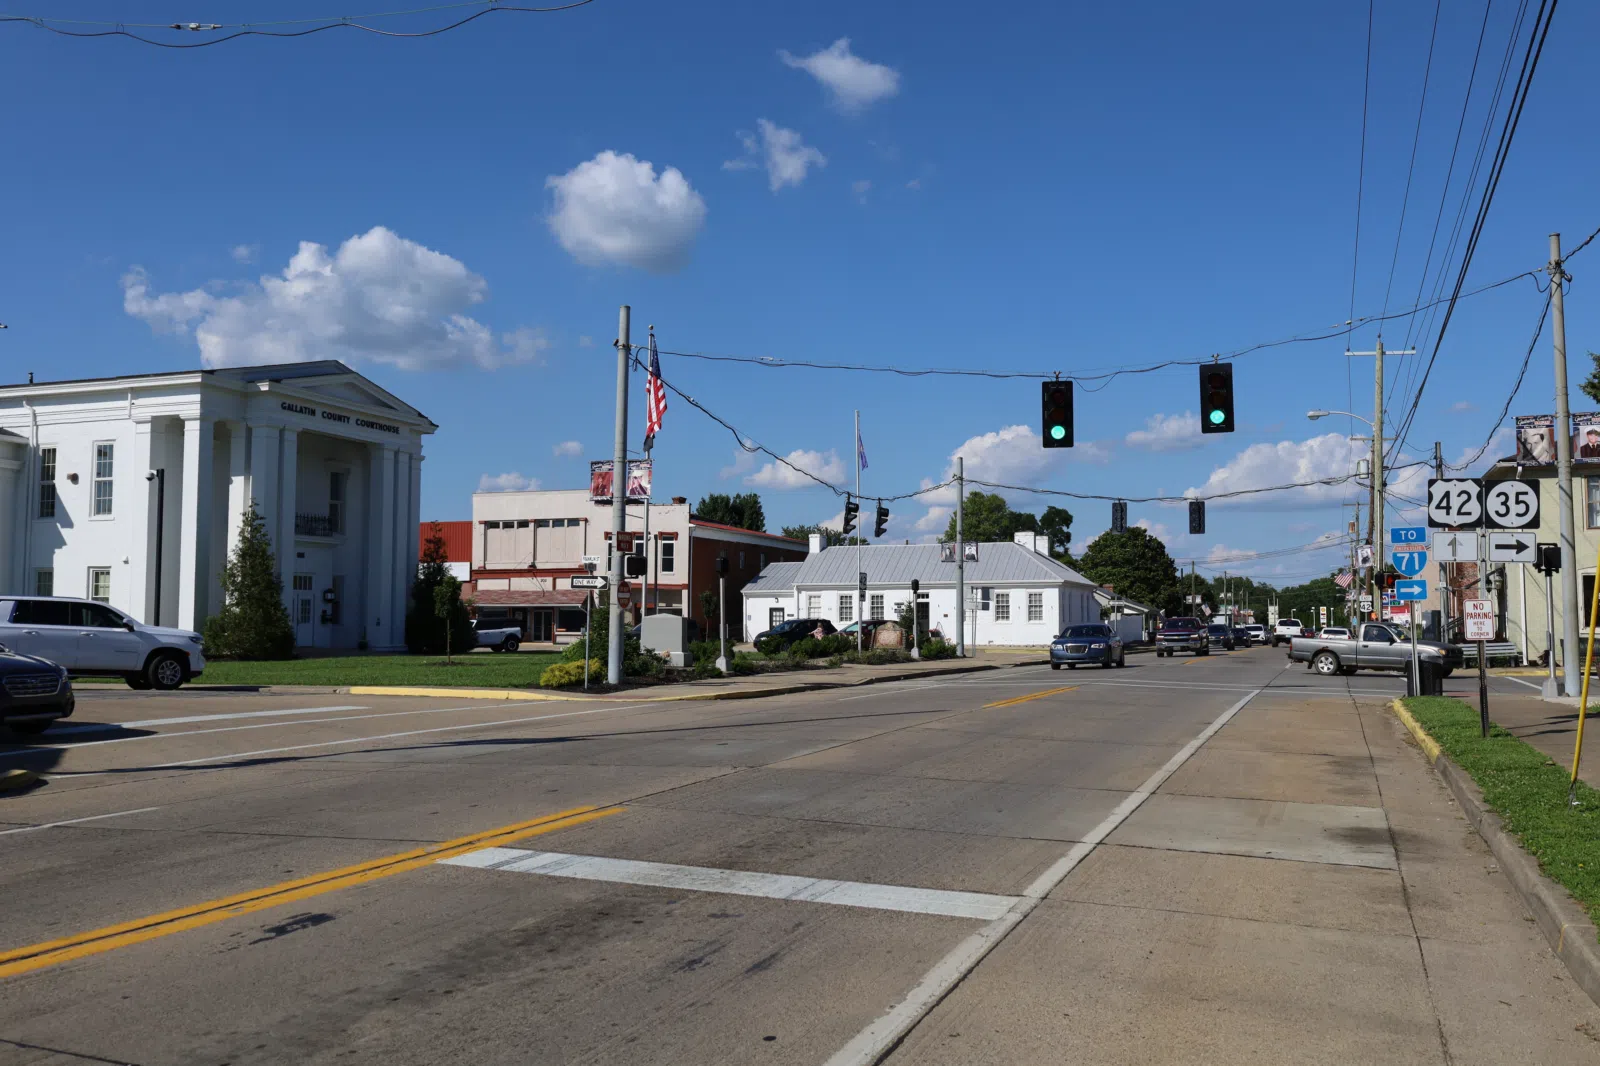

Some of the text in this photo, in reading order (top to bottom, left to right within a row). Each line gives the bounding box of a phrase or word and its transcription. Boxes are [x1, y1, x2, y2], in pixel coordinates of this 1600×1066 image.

[281, 402, 400, 434] GALLATIN COUNTY COURTHOUSE
[1434, 489, 1473, 516] 42
[1494, 491, 1530, 518] 35
[1399, 530, 1417, 540] TO
[1396, 552, 1420, 571] 71
[1360, 603, 1372, 611] 42
[1472, 602, 1485, 611] NO
[1466, 611, 1492, 620] PARKING
